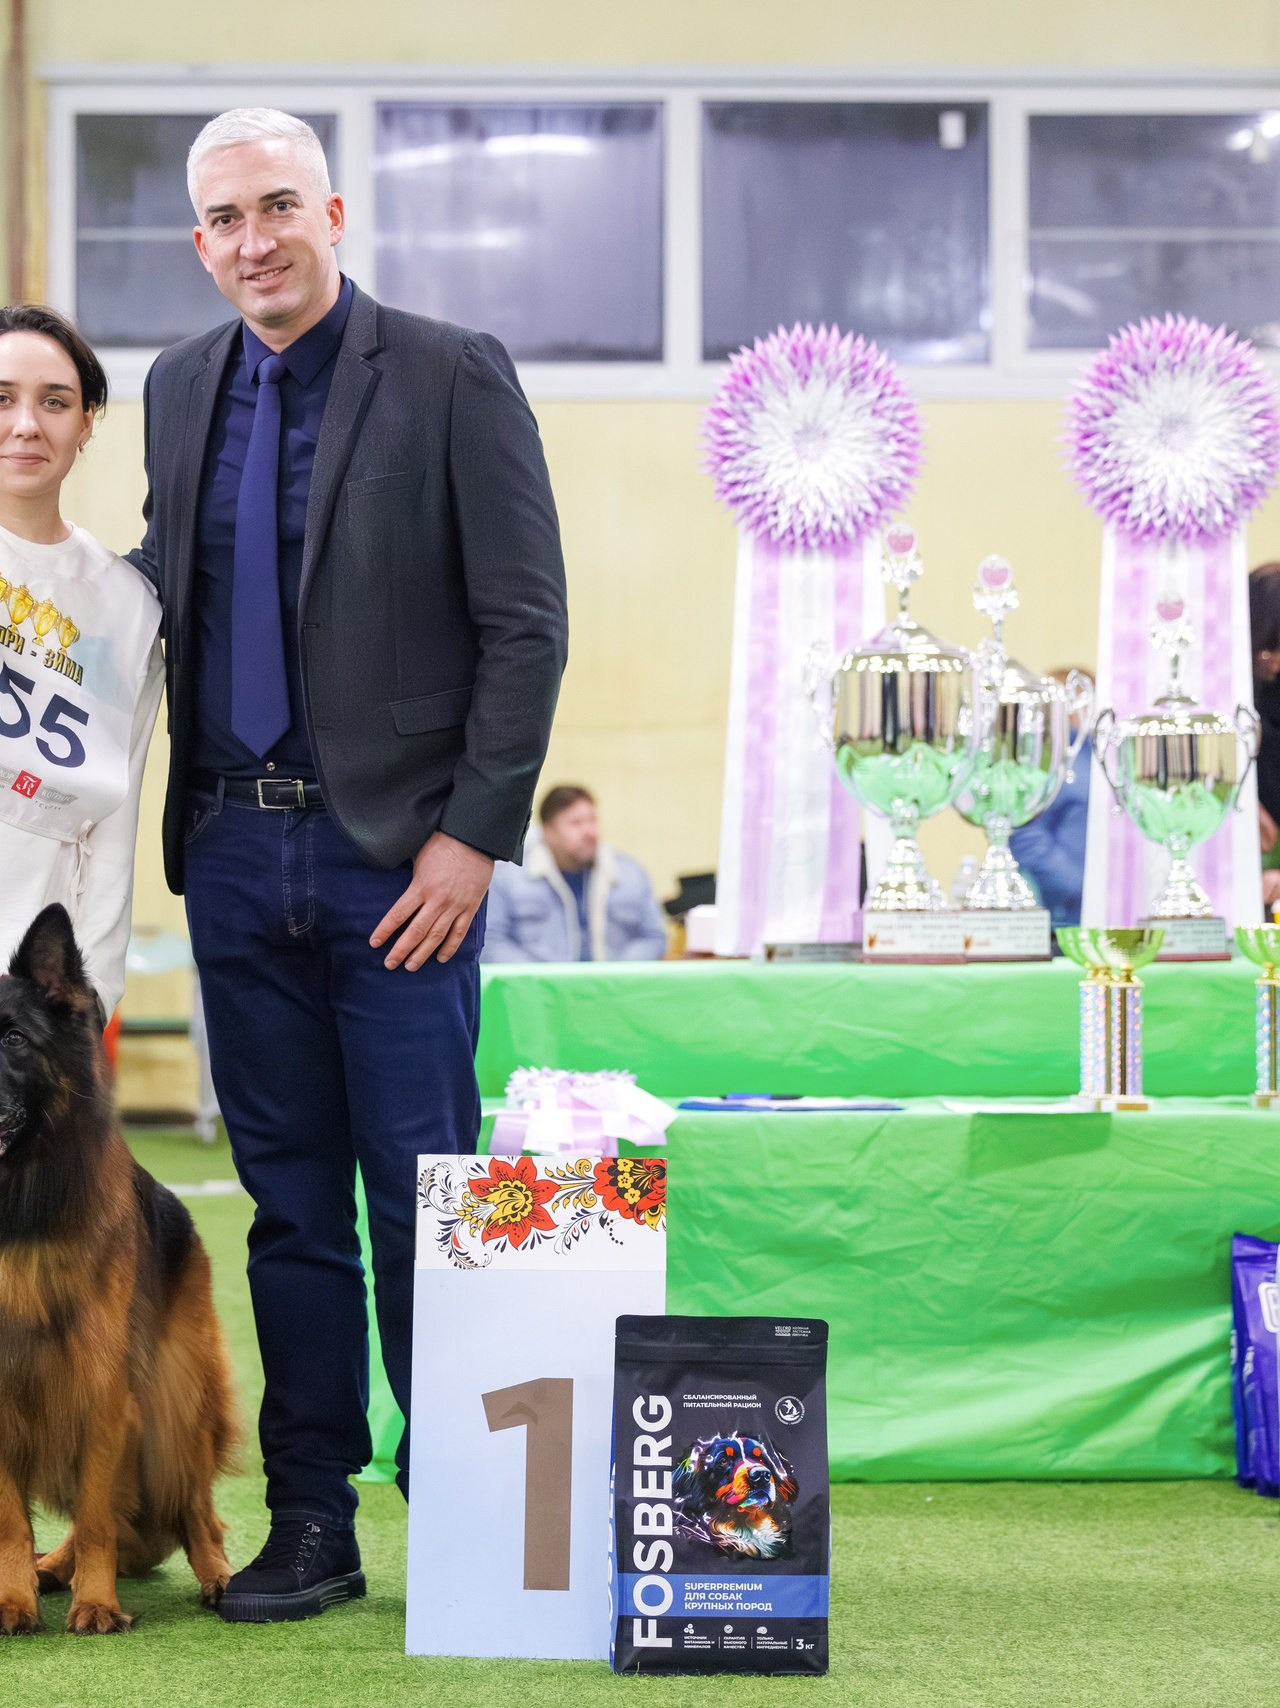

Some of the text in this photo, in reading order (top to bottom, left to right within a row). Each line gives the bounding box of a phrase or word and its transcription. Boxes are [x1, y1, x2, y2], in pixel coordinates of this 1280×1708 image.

[43, 649, 84, 687] ЗИМА
[481, 1377, 574, 1591] 1
[632, 1394, 674, 1648] FOSBERG
[684, 1582, 763, 1591] SUPERPREMIUM
[684, 1592, 743, 1601] ДЛЯ СОБАК
[684, 1602, 773, 1612] КРУПНЫХ ПОРОД
[795, 1638, 805, 1650] 3
